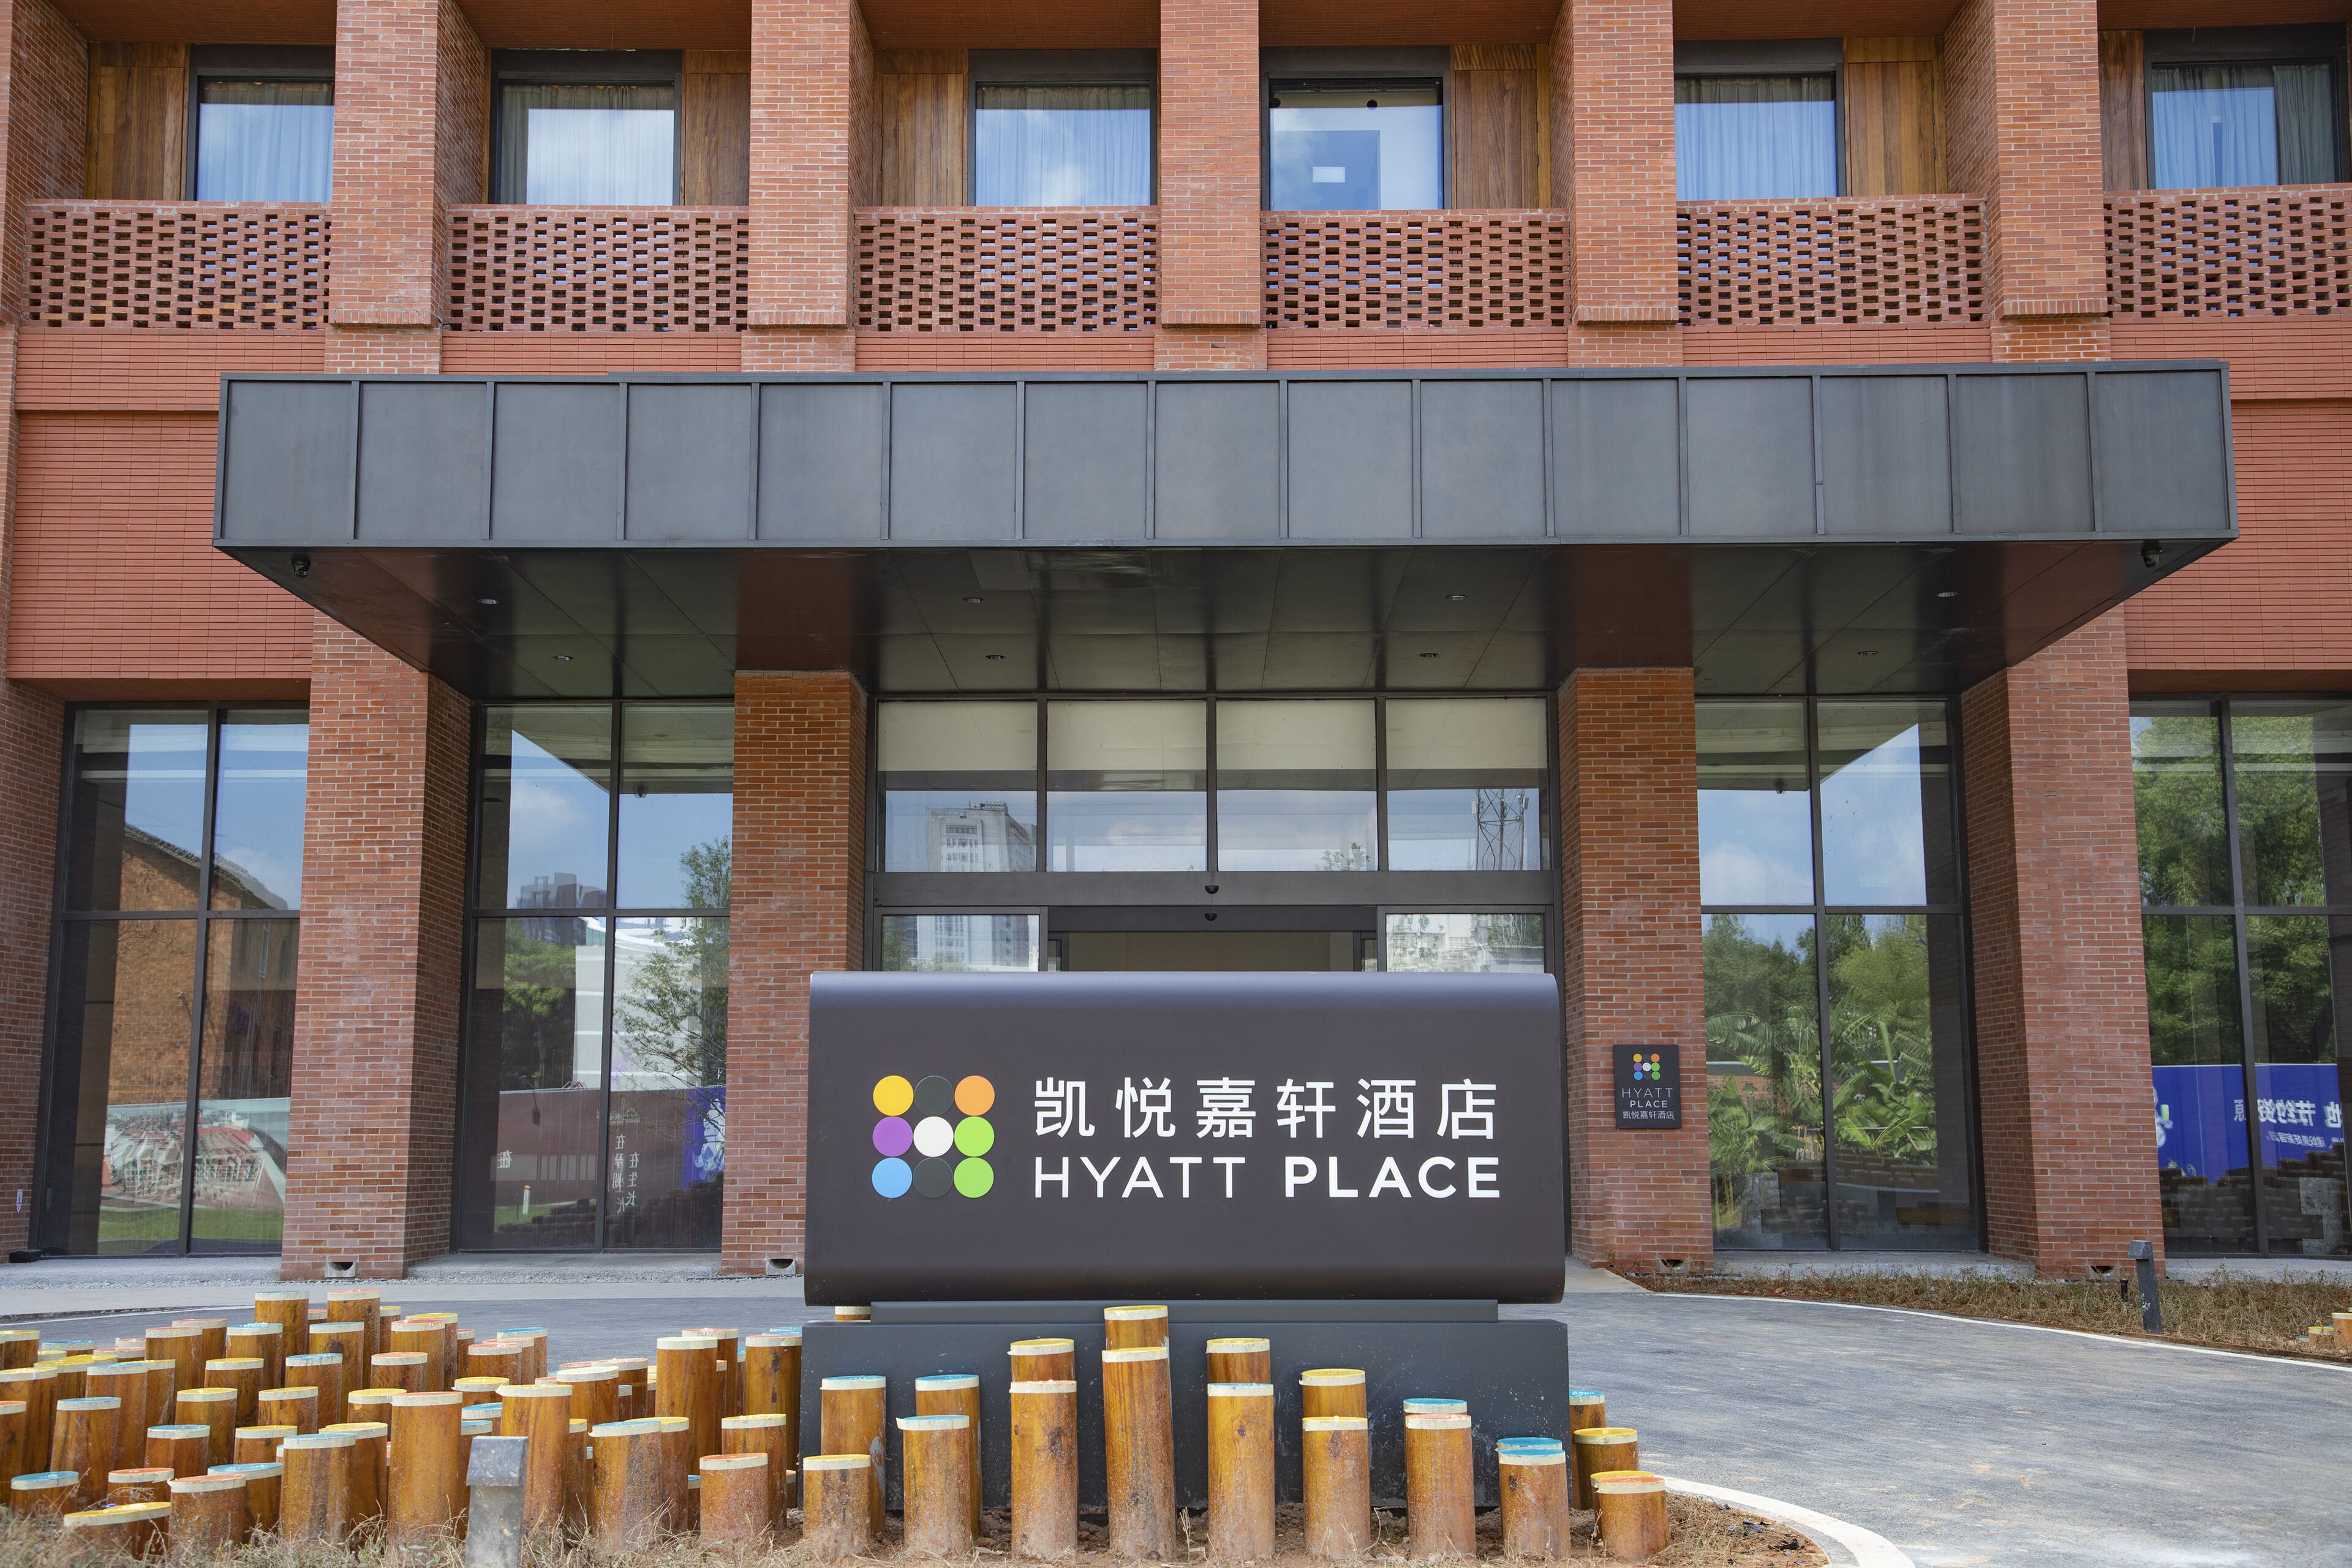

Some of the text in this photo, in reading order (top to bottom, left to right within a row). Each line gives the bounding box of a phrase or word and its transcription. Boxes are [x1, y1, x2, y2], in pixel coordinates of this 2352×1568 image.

[1622, 1088, 1673, 1098] HYATT
[1035, 1077, 1496, 1140] 凯悦嘉轩酒店
[1623, 1110, 1675, 1120] 凯悦嘉轩酒店
[1035, 1156, 1500, 1199] HYATT PLACE
